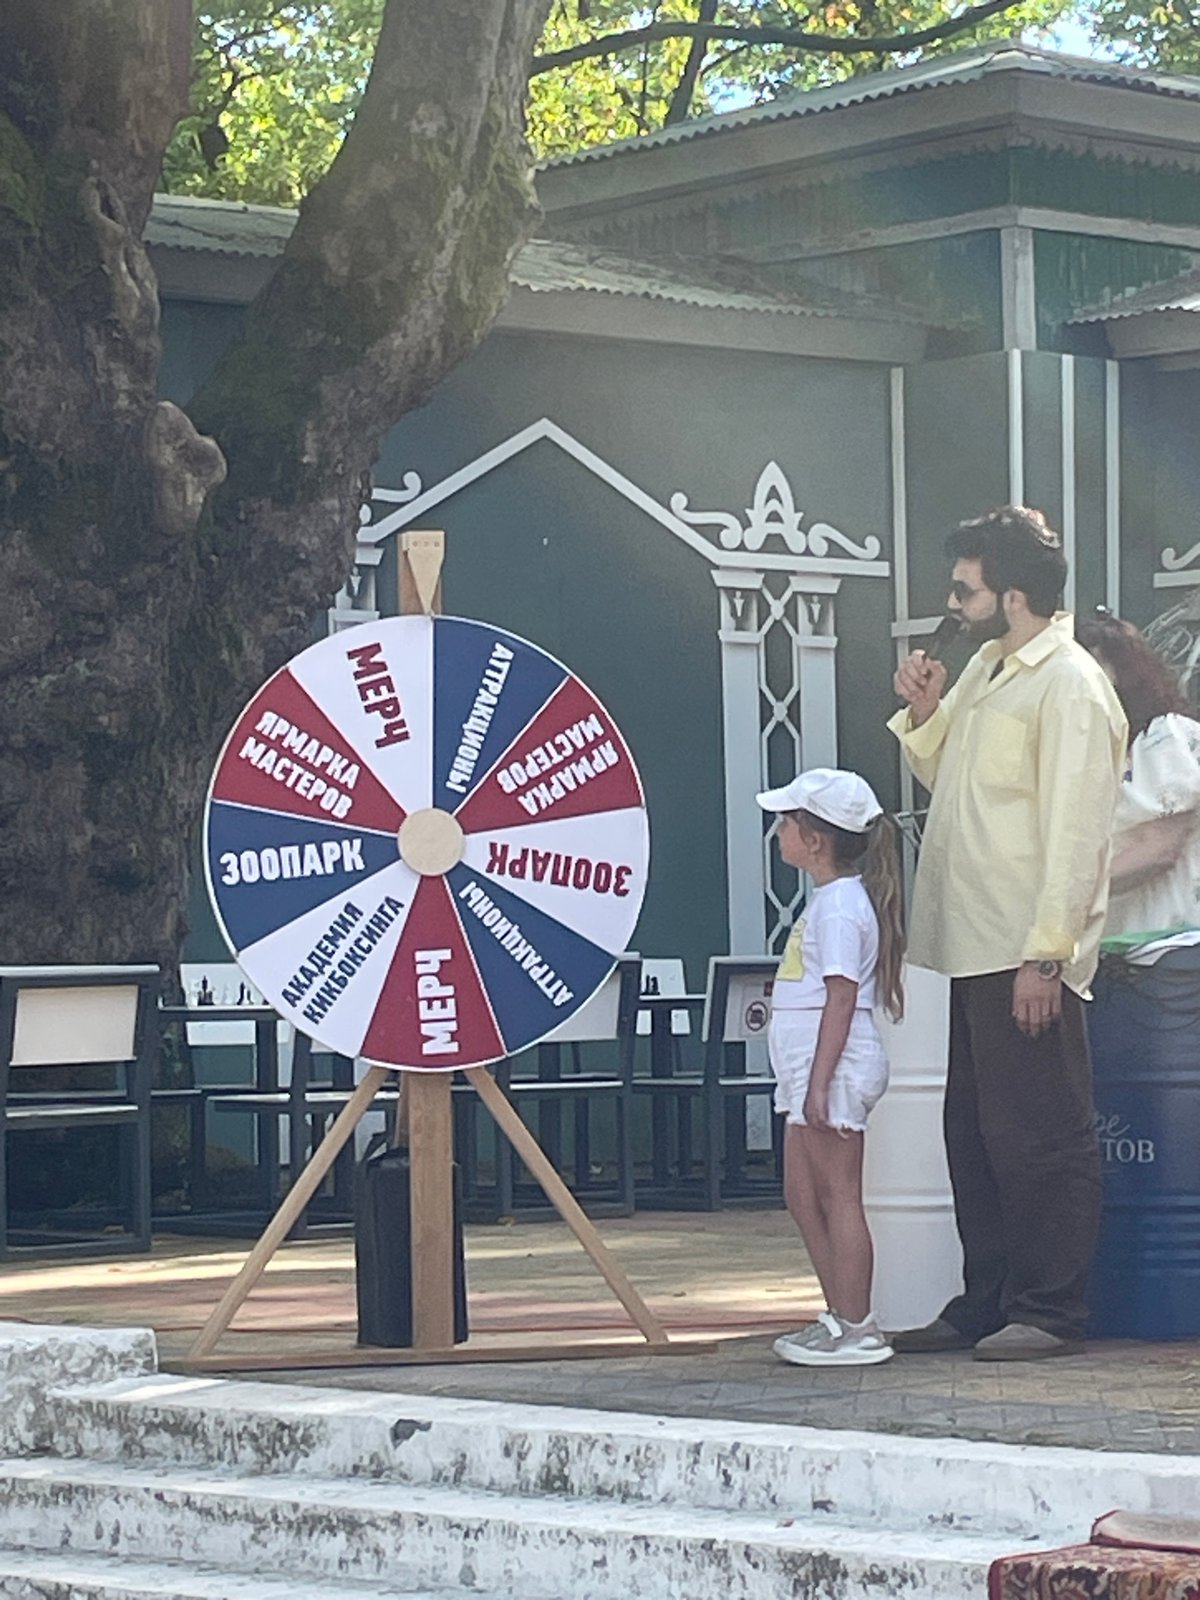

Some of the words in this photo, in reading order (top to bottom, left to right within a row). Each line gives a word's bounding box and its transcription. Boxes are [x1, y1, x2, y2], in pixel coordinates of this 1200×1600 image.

[346, 643, 410, 748] МЕРЧ
[445, 642, 514, 793] АТТРАКЦИОНЫ
[238, 736, 353, 819] МАСТЕРОВ
[254, 710, 361, 789] ЯРМАРКА
[497, 713, 604, 794] МАСТЕРОВ
[517, 740, 619, 816] ЯРМАРКА
[220, 838, 365, 885] ЗООПАРК
[485, 842, 632, 897] ЗООПАРК
[281, 901, 364, 1008] АКАДЕМИЯ
[302, 896, 405, 1025] КИКБОКСИНГА
[458, 881, 575, 1007] АТТРАКЦИОНЫ
[415, 948, 459, 1055] МЕРЧ
